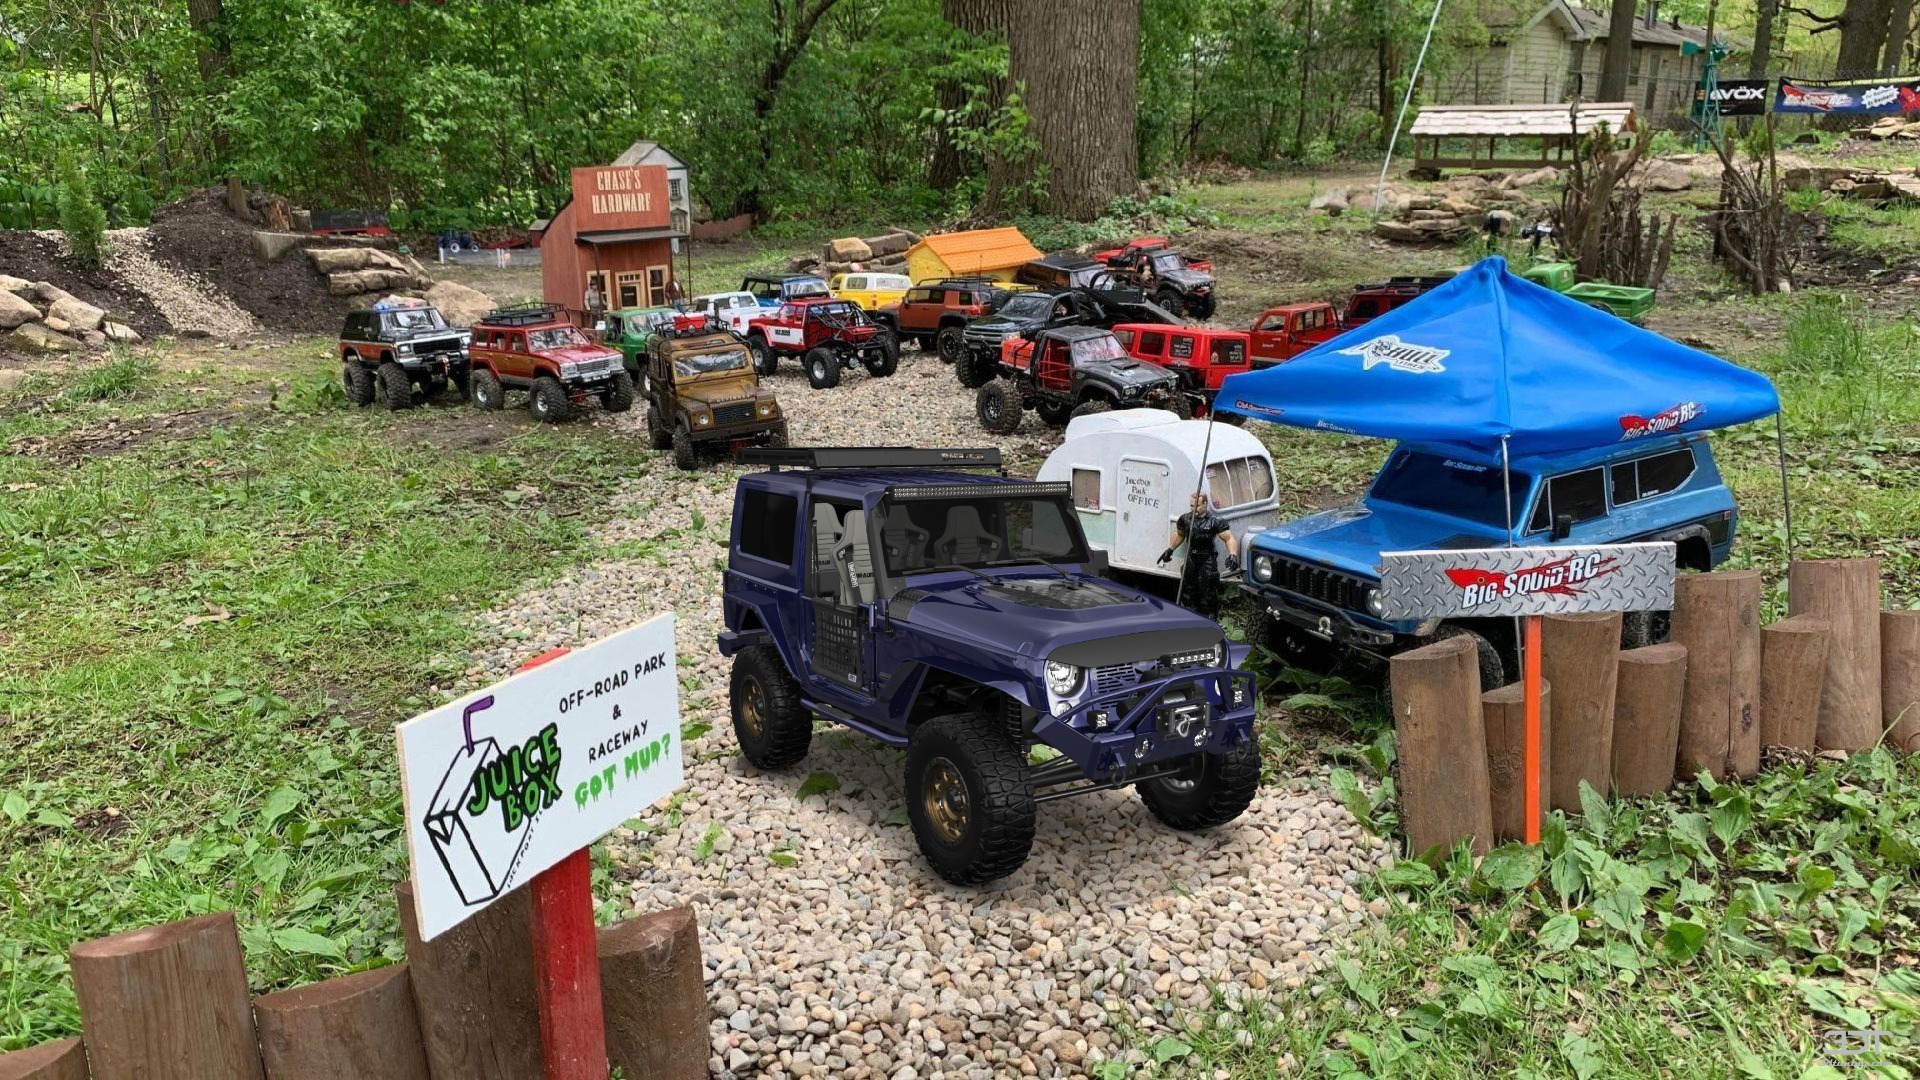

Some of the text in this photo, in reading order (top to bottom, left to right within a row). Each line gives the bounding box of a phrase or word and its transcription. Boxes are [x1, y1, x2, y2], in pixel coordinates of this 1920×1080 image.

[596, 164, 641, 191] CHASE'S
[591, 192, 652, 214] HARDWARE
[1127, 493, 1160, 509] OFFICE
[1568, 553, 1601, 583] RC
[559, 652, 667, 714] OFF-ROAD PARK
[612, 703, 622, 721] &
[588, 718, 648, 764] RACEWAY
[466, 722, 562, 817] JUICE
[574, 732, 671, 813] GOT MUD?
[502, 767, 563, 833] BOX
